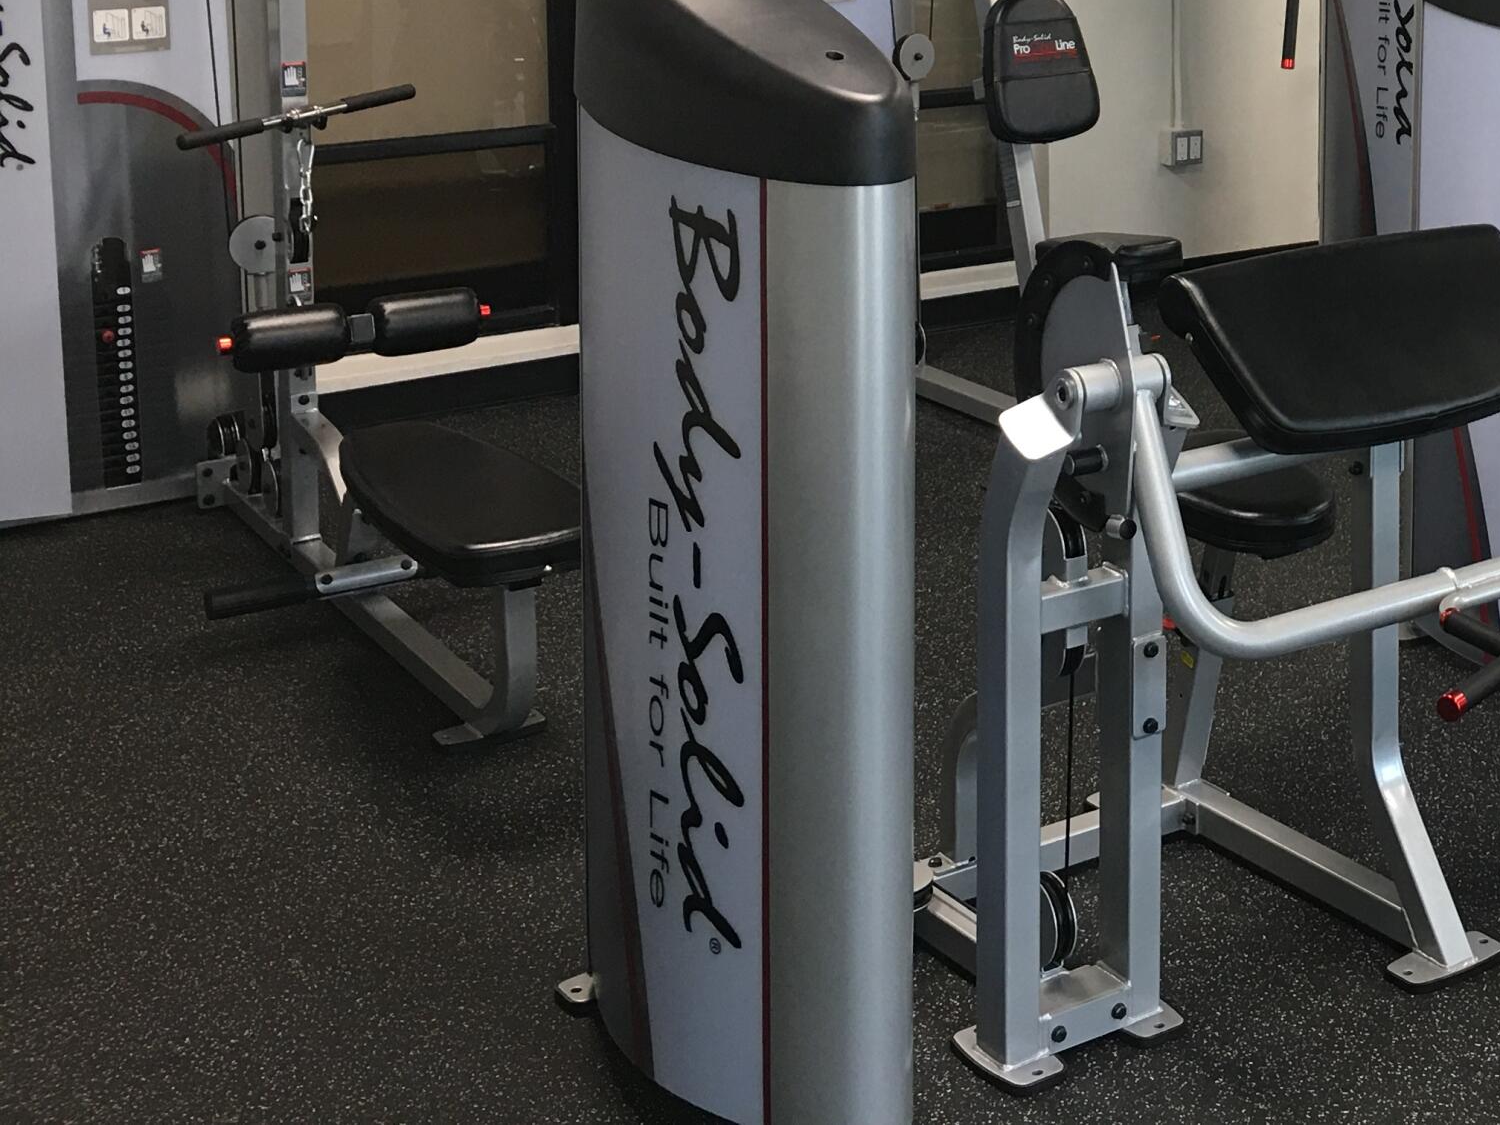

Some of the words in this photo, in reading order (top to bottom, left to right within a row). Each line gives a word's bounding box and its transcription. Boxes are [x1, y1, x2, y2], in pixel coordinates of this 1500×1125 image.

[1377, 35, 1389, 75] for
[1375, 86, 1389, 138] Life
[648, 497, 669, 649] Built
[654, 195, 743, 948] Body-Solid
[648, 674, 669, 767] for
[649, 790, 669, 908] Life
